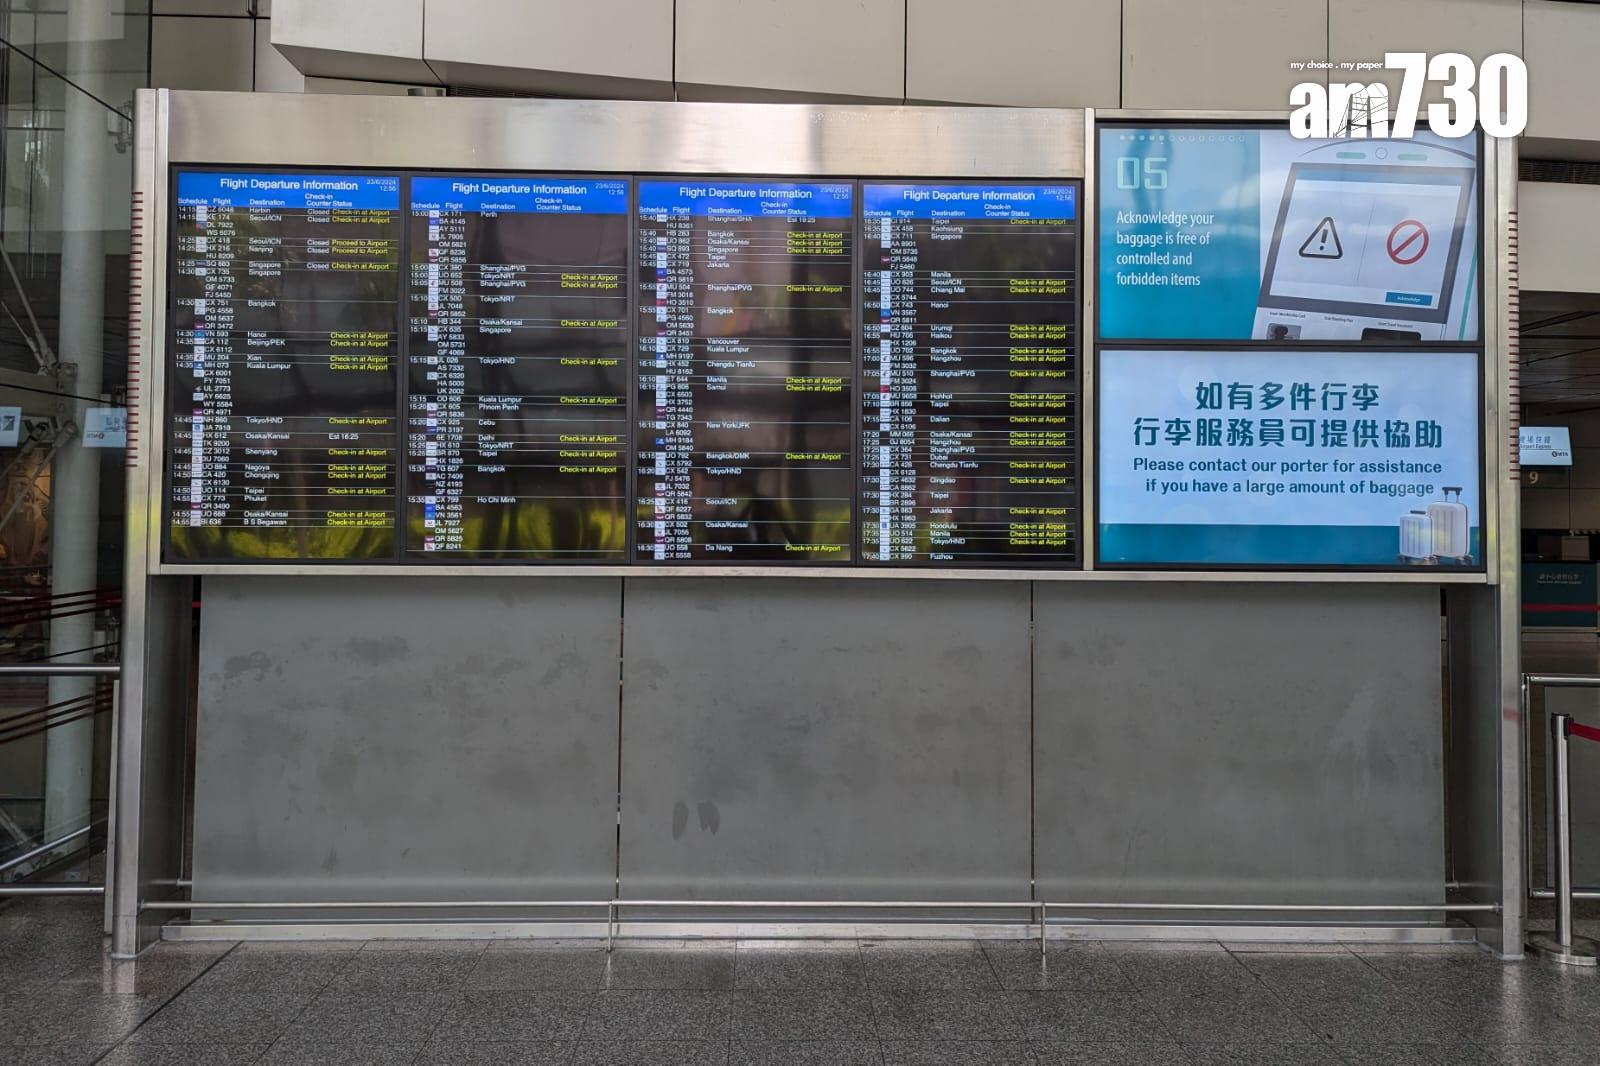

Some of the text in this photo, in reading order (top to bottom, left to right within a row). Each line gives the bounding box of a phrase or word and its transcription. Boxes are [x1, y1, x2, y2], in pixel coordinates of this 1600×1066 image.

[1117, 157, 1168, 189] 05
[220, 179, 358, 190] Flight Departure Information
[453, 184, 587, 194] Flight Departure Information
[679, 188, 812, 199] Flight Departure Information
[904, 191, 1035, 201] Flight Departure Information
[1117, 211, 1214, 227] Acknowledge your
[1117, 232, 1210, 247] baggage is free of
[1117, 252, 1192, 265] controlled and
[1117, 272, 1200, 285] forbidden items
[1196, 381, 1379, 411] 如有多件行李
[1134, 417, 1442, 448] 行李服務員可提供協助
[1133, 458, 1442, 475] Please contact our porter for assistance
[1529, 472, 1538, 484] 9
[1146, 479, 1434, 496] if you have a large amount of baggage
